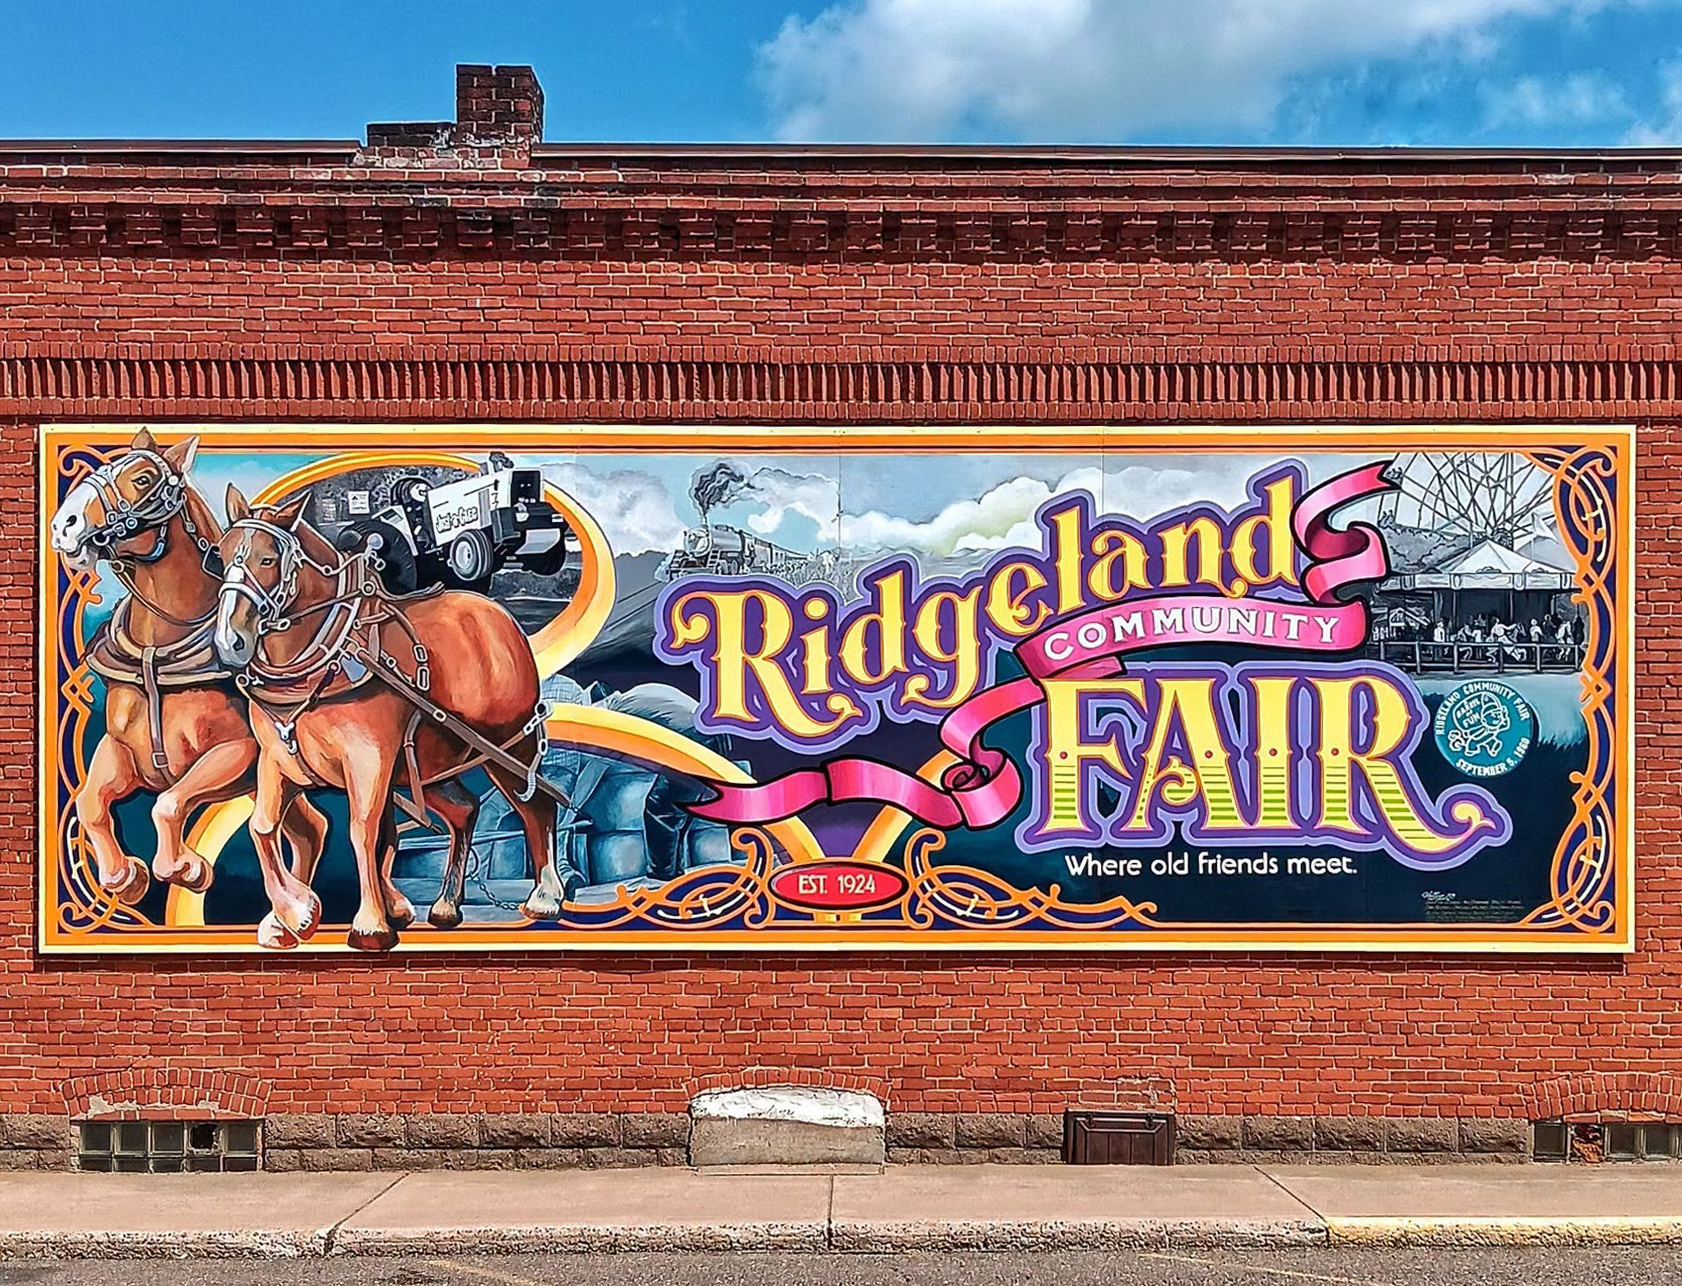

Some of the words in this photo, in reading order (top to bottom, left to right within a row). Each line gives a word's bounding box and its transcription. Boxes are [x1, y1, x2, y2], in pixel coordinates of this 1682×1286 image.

[671, 476, 1301, 737] Ridgeland
[1044, 605, 1339, 662] COMMUNITY
[1435, 691, 1461, 736] RIDGELAND
[1462, 682, 1516, 700] COMMUNITY
[1513, 698, 1531, 721] FAIR
[1462, 712, 1481, 729] FUN
[1035, 677, 1496, 853] FAIR
[1455, 759, 1508, 777] SEPTEMBER
[1064, 852, 1143, 876] Where
[1150, 851, 1189, 875] old
[1198, 851, 1278, 875] friends
[1287, 855, 1358, 875] meet.
[798, 874, 828, 895] EST.
[837, 873, 876, 894] 1924
